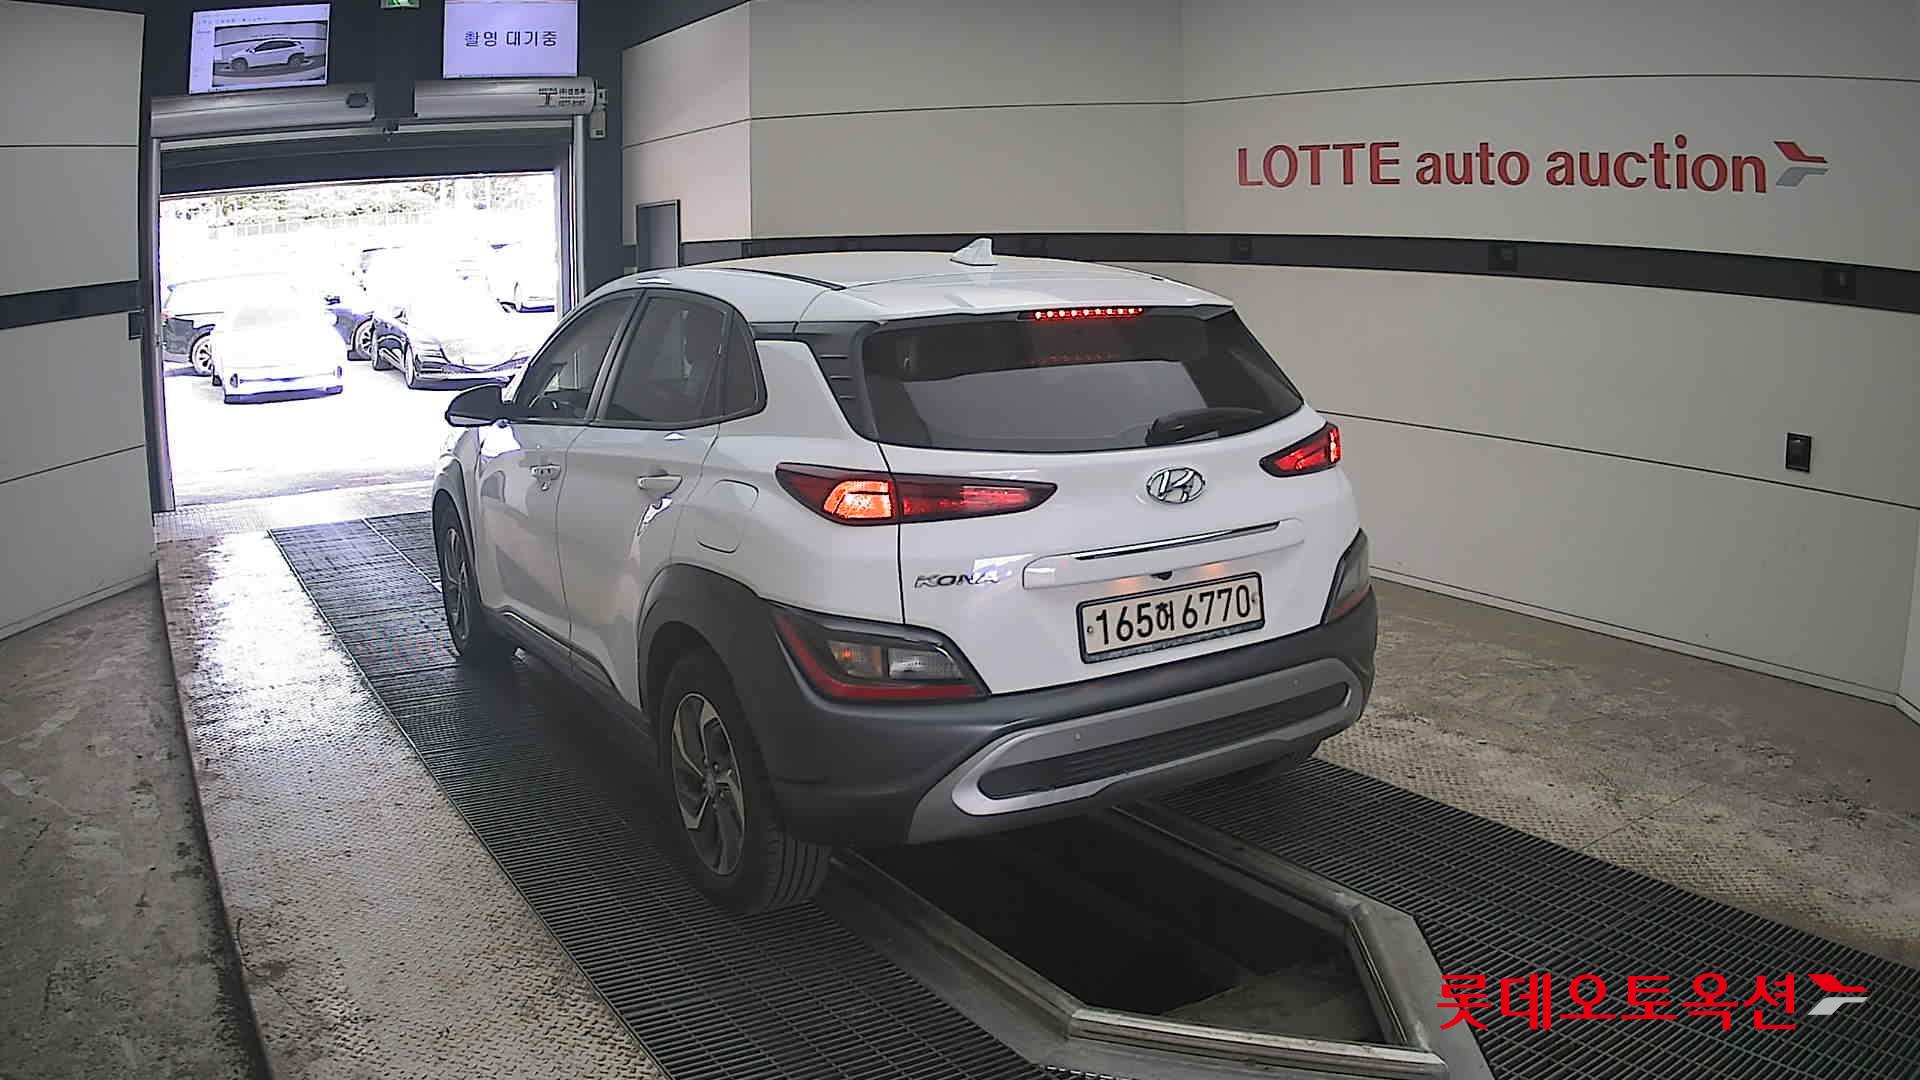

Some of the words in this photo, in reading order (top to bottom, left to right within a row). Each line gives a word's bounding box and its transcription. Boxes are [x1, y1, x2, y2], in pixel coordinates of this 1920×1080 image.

[464, 30, 497, 47] 촬영
[506, 30, 557, 47] 대기중
[1236, 142, 1399, 188] LOTTE
[1416, 143, 1533, 186] auto
[1546, 135, 1767, 193] auction
[914, 573, 1001, 589] KONA
